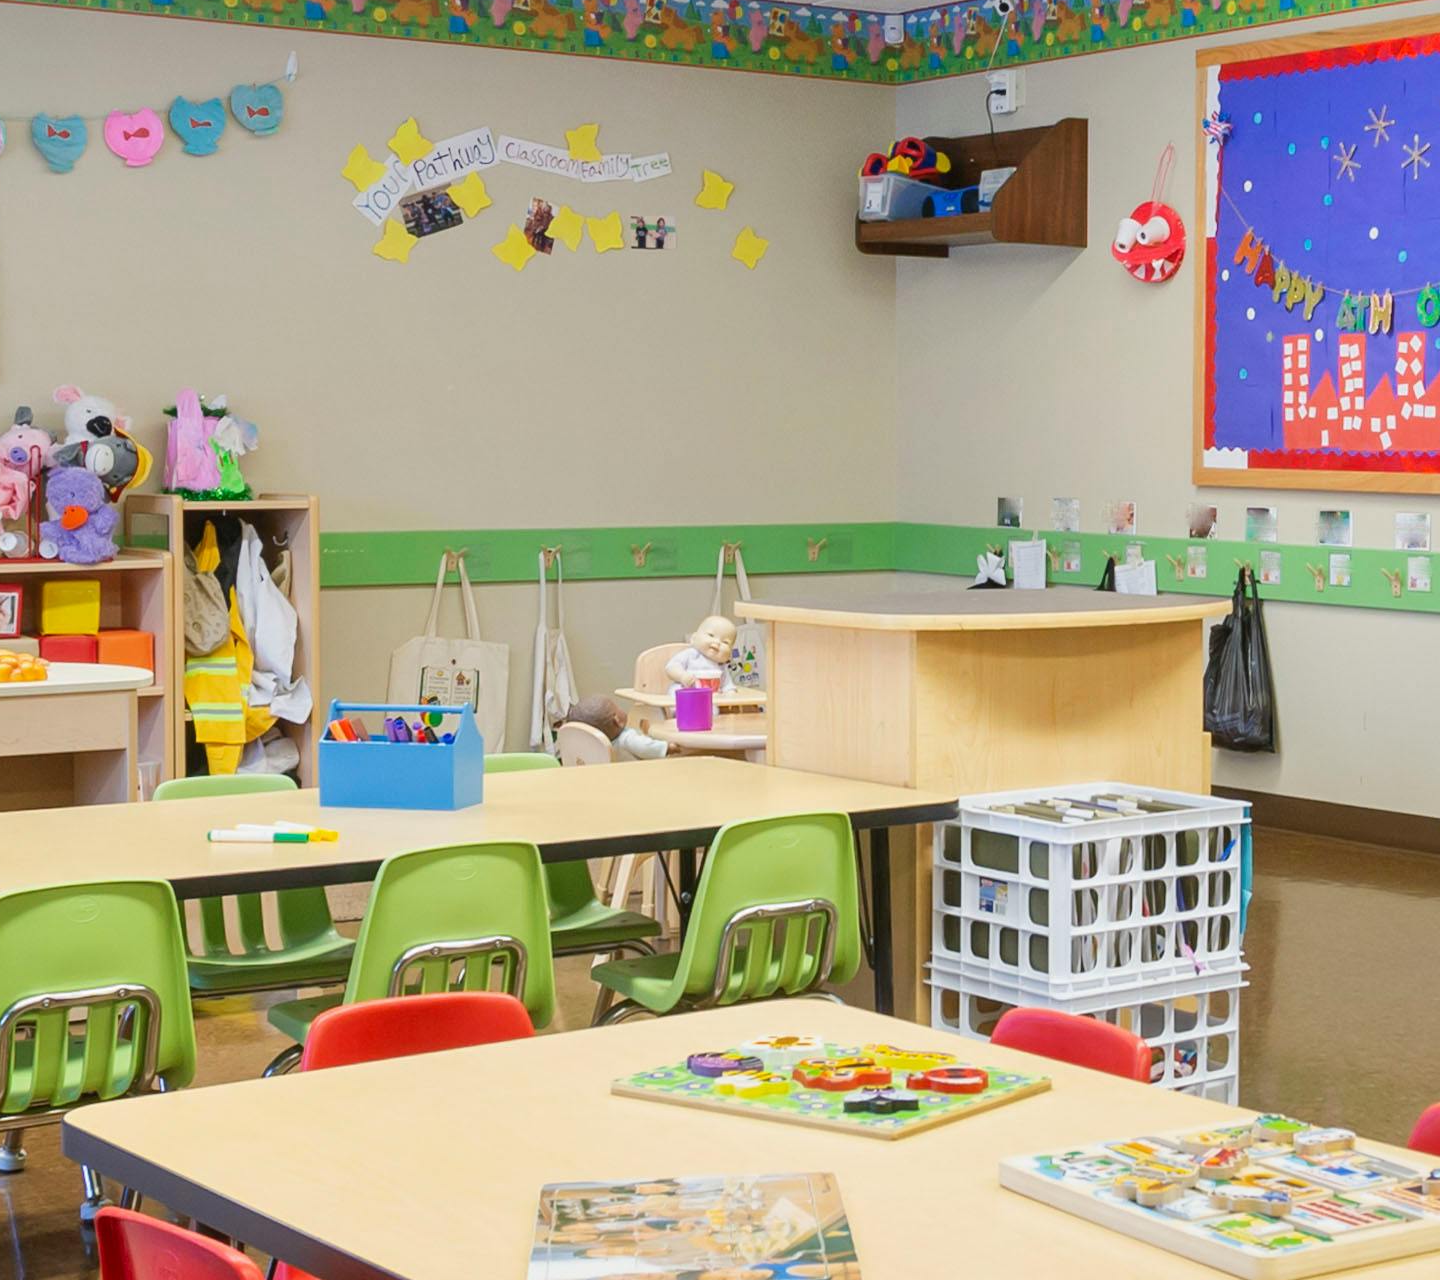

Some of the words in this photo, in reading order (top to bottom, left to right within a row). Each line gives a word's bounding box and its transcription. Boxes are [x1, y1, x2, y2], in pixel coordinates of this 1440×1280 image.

[413, 132, 495, 187] Pathway
[505, 141, 583, 176] Classroom
[580, 157, 631, 178] Family
[629, 157, 670, 179] Tree
[1234, 228, 1325, 322] HAPPY
[1335, 293, 1394, 335] 4TH
